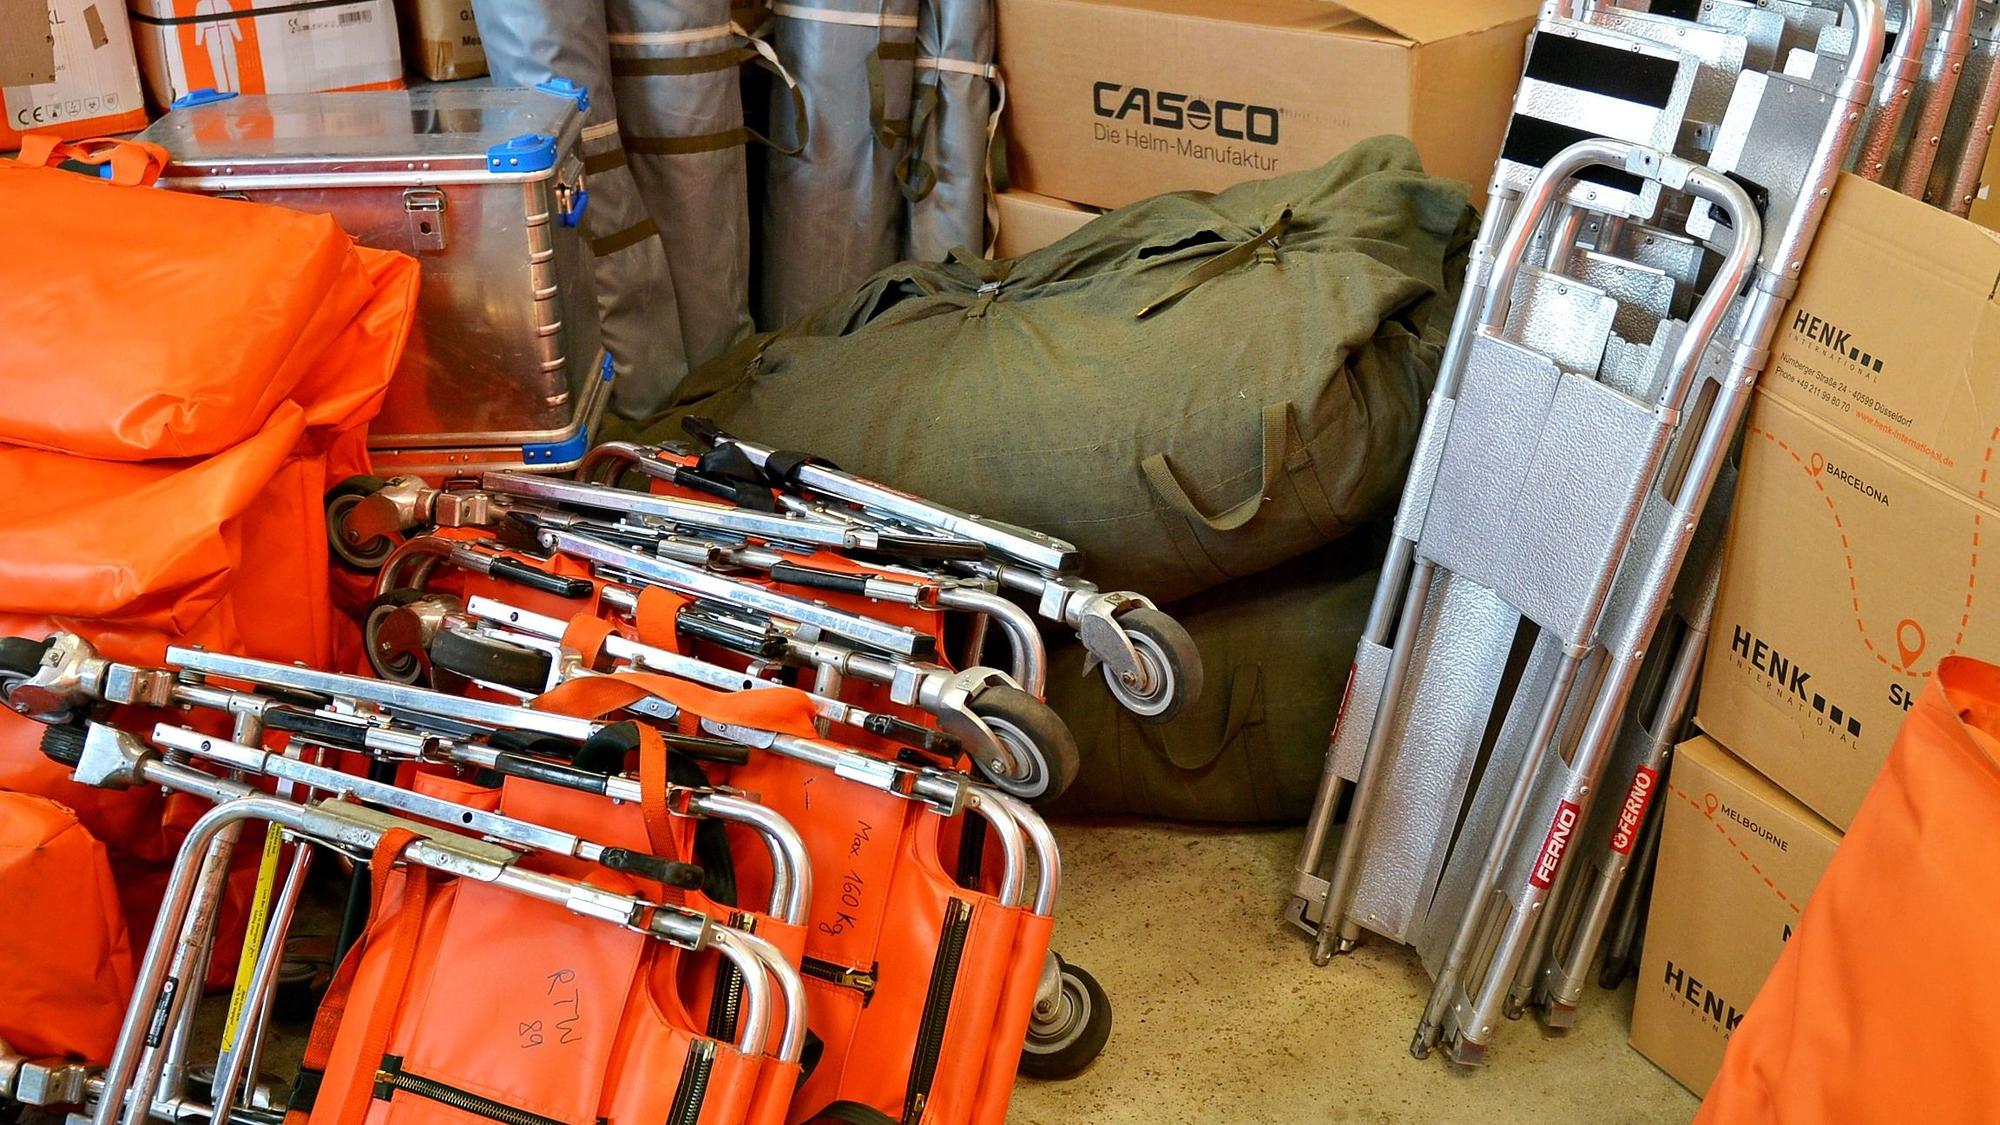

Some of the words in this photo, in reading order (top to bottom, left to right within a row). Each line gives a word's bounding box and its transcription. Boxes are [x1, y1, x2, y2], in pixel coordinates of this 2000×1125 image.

[1094, 122, 1120, 144] Die
[1126, 128, 1279, 171] Helm-Manufaktur
[1793, 309, 1852, 355] HENK
[1789, 333, 1878, 384] INTERNATIONAL
[1775, 365, 1795, 383] Phone
[1808, 384, 1821, 396] 211
[1840, 401, 1851, 413] 70
[1780, 352, 1816, 375] Nürnberger
[1815, 370, 1837, 388] Straße
[1837, 382, 1848, 393] 24
[1852, 390, 1874, 407] 40599
[1873, 401, 1913, 427] Düsseldorf
[1826, 462, 1889, 507] BARCELONA
[1731, 624, 1811, 702] HENK
[1729, 654, 1857, 750] INTERNATIONAL
[1618, 772, 1651, 836] FERNO
[1721, 804, 1789, 852] MELBOURNE
[1536, 808, 1577, 883] FERNO
[841, 869, 864, 908] 160
[547, 968, 582, 1044] RTW
[519, 1020, 543, 1049] 89
